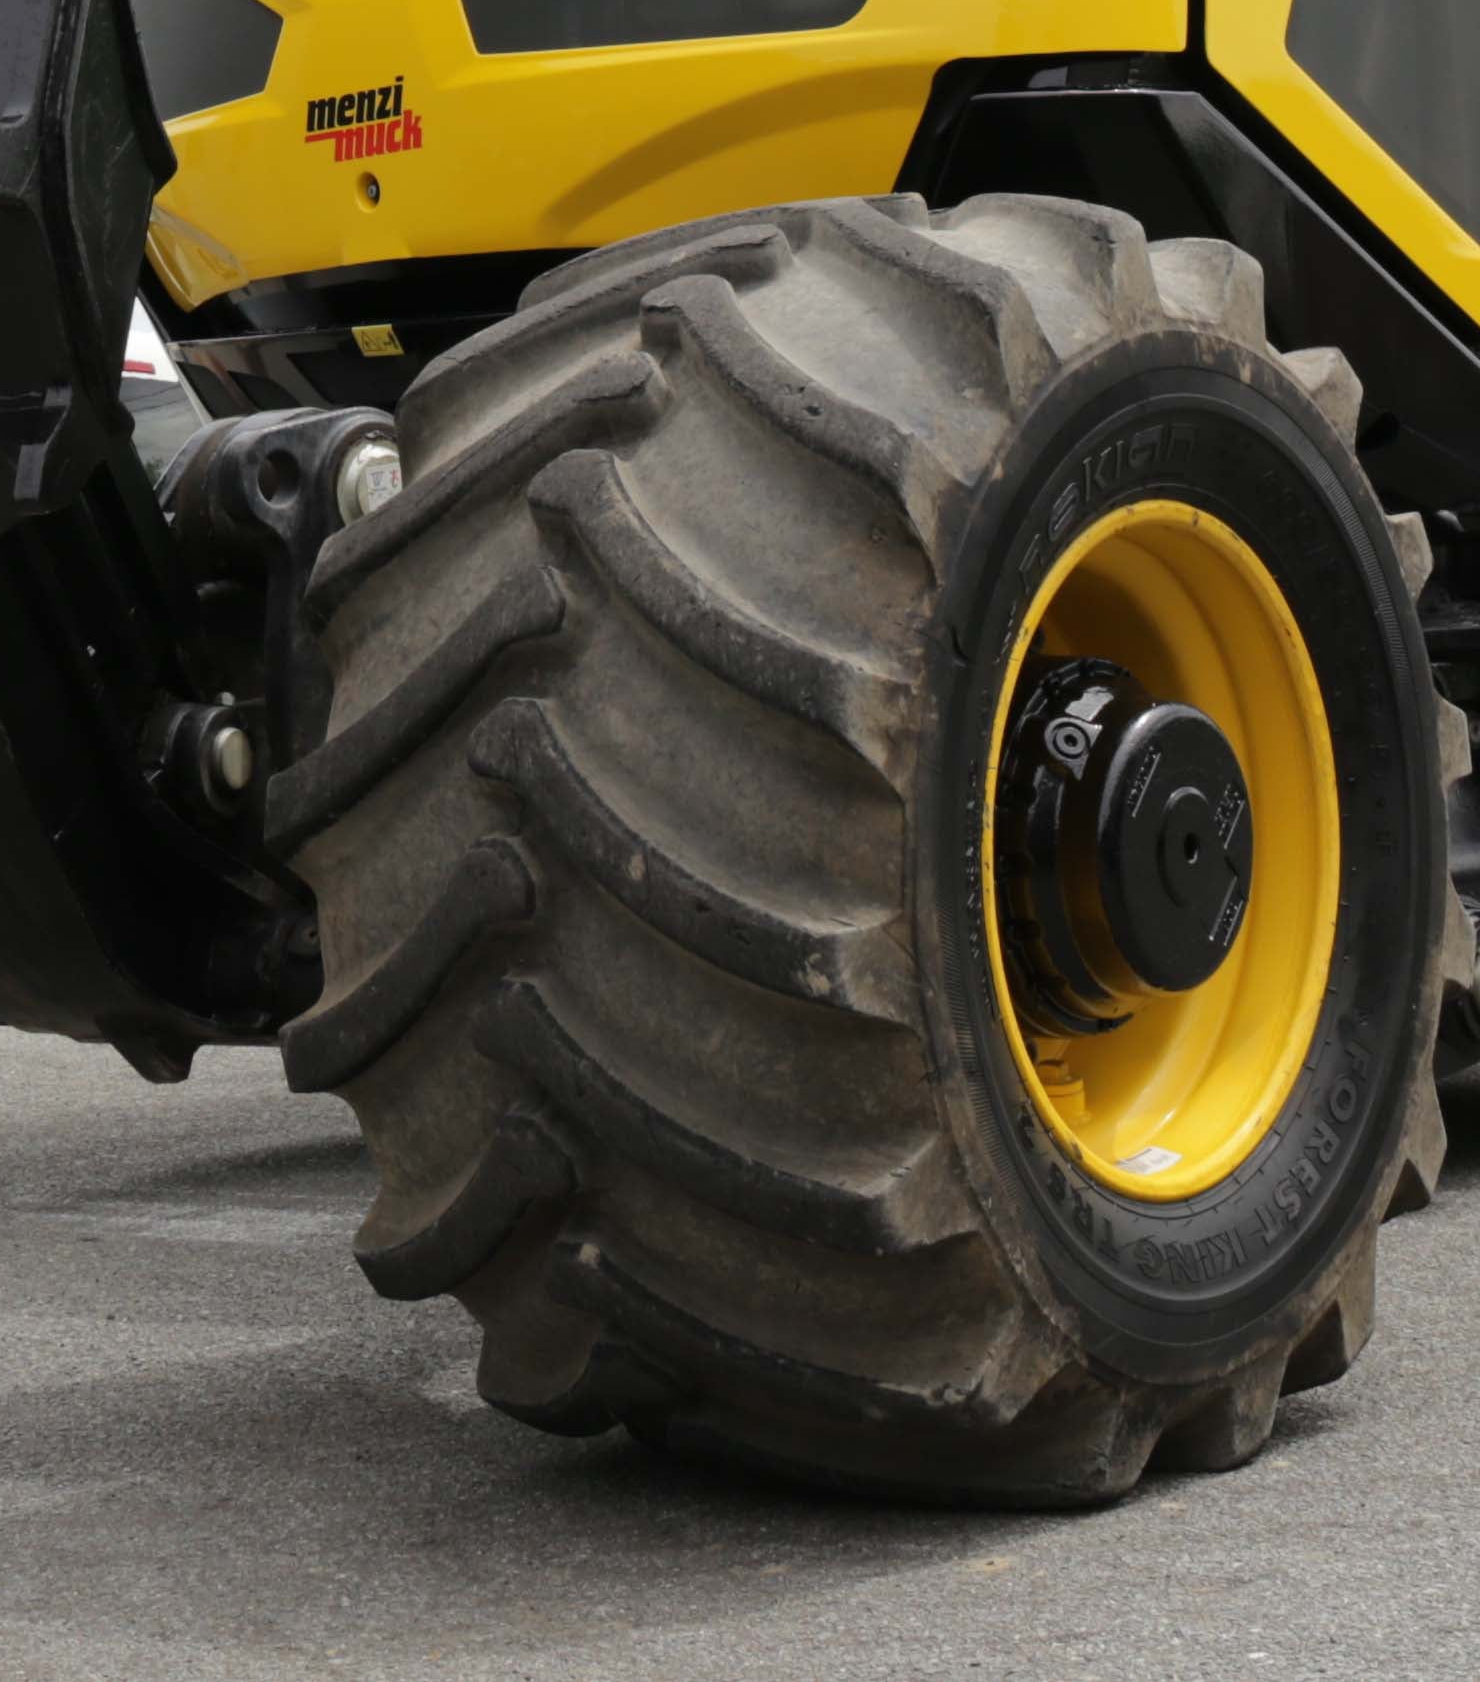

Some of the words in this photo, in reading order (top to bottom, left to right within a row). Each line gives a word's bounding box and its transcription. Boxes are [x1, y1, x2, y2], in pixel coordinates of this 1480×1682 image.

[306, 75, 404, 133] menzi
[305, 109, 422, 162] muck
[1251, 1038, 1375, 1246] FOREST
[1133, 1227, 1249, 1286] KING
